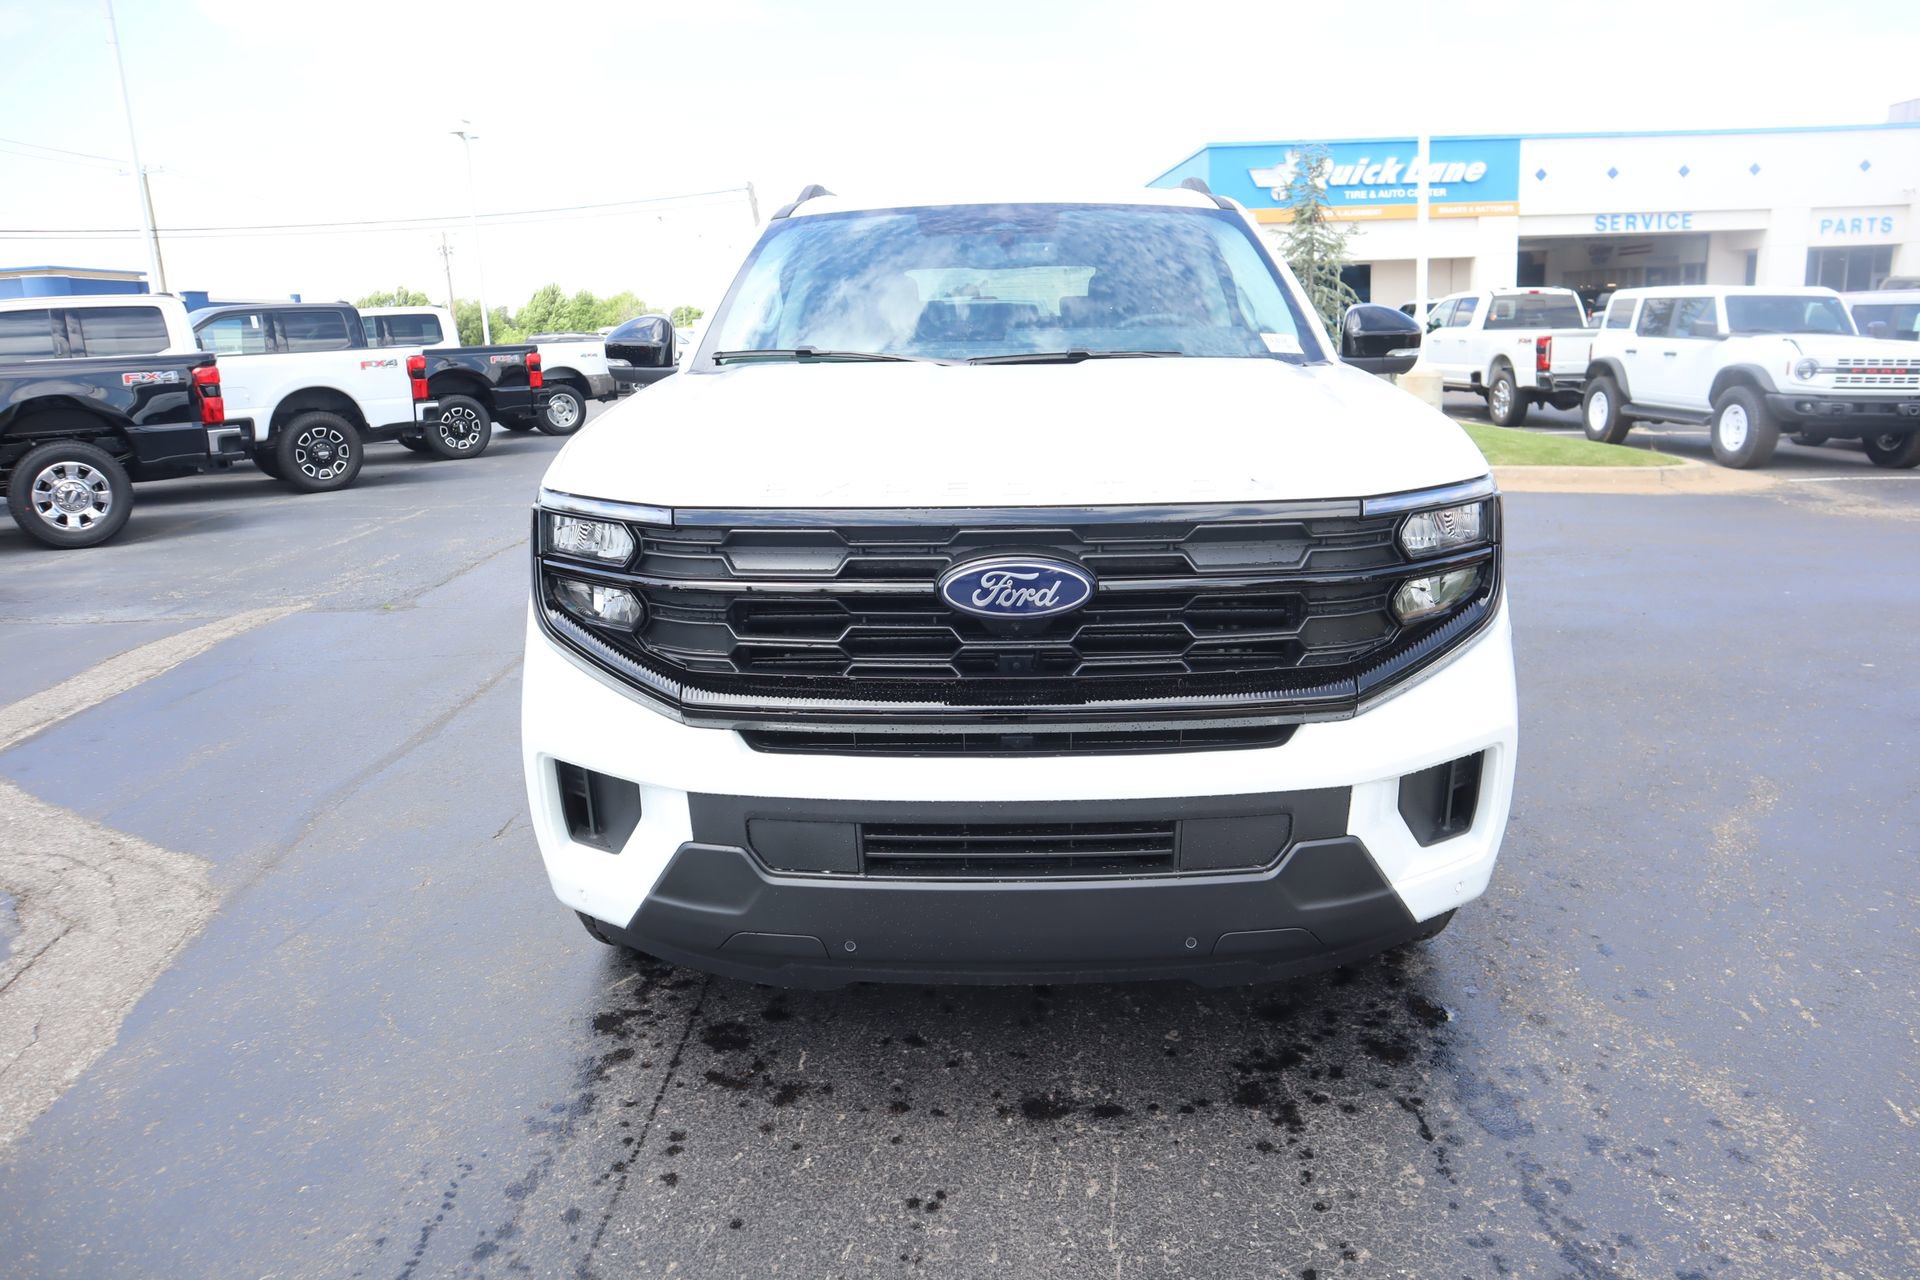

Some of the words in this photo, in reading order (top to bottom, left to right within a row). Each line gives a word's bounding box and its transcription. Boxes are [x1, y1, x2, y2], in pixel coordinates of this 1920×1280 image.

[1344, 190, 1367, 199] TIRE
[1368, 190, 1377, 199] &
[1378, 188, 1405, 199] AUTO
[1407, 187, 1447, 198] CTER
[1594, 212, 1693, 232] SERVICE
[1820, 216, 1894, 235] PARTS
[360, 358, 398, 370] FX4
[121, 371, 179, 386] FX4
[971, 570, 1062, 607] Ford
